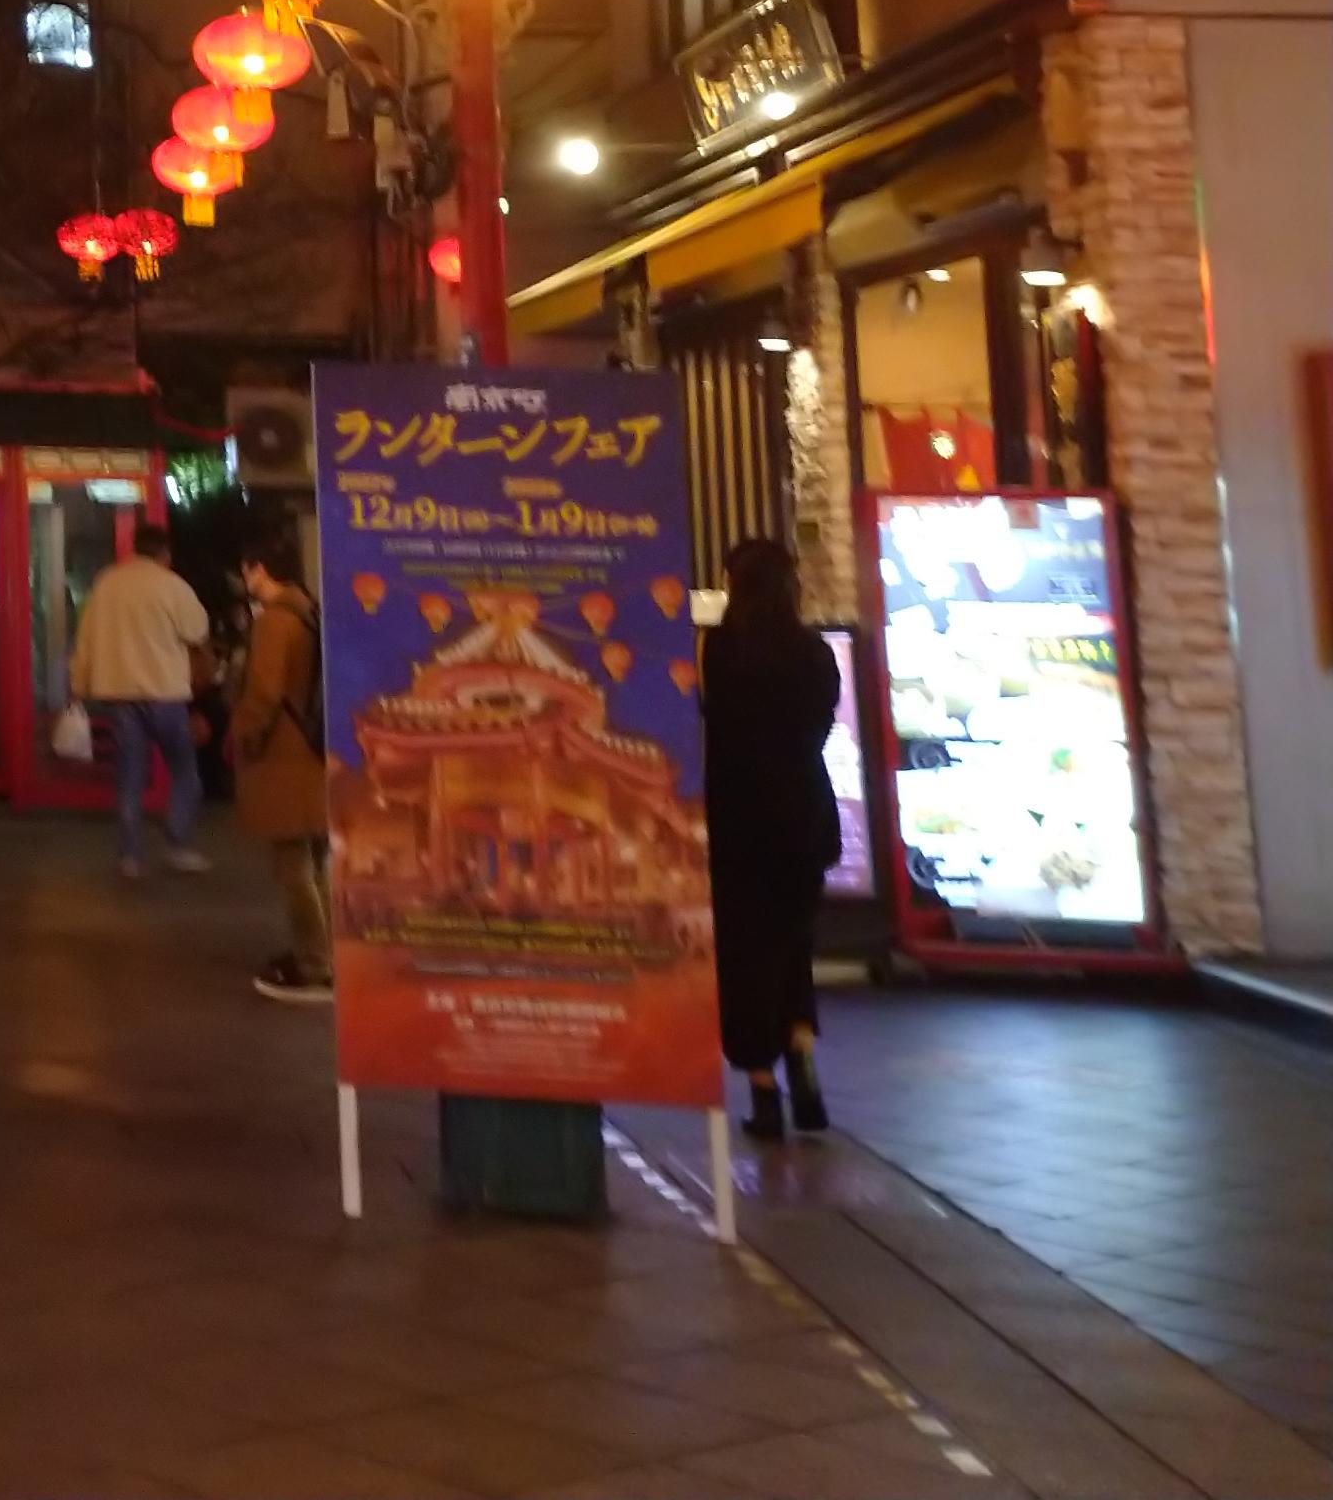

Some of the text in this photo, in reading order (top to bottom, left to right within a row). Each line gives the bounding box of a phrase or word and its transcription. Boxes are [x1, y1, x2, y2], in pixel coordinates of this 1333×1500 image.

[334, 409, 663, 467] ランターンフェア
